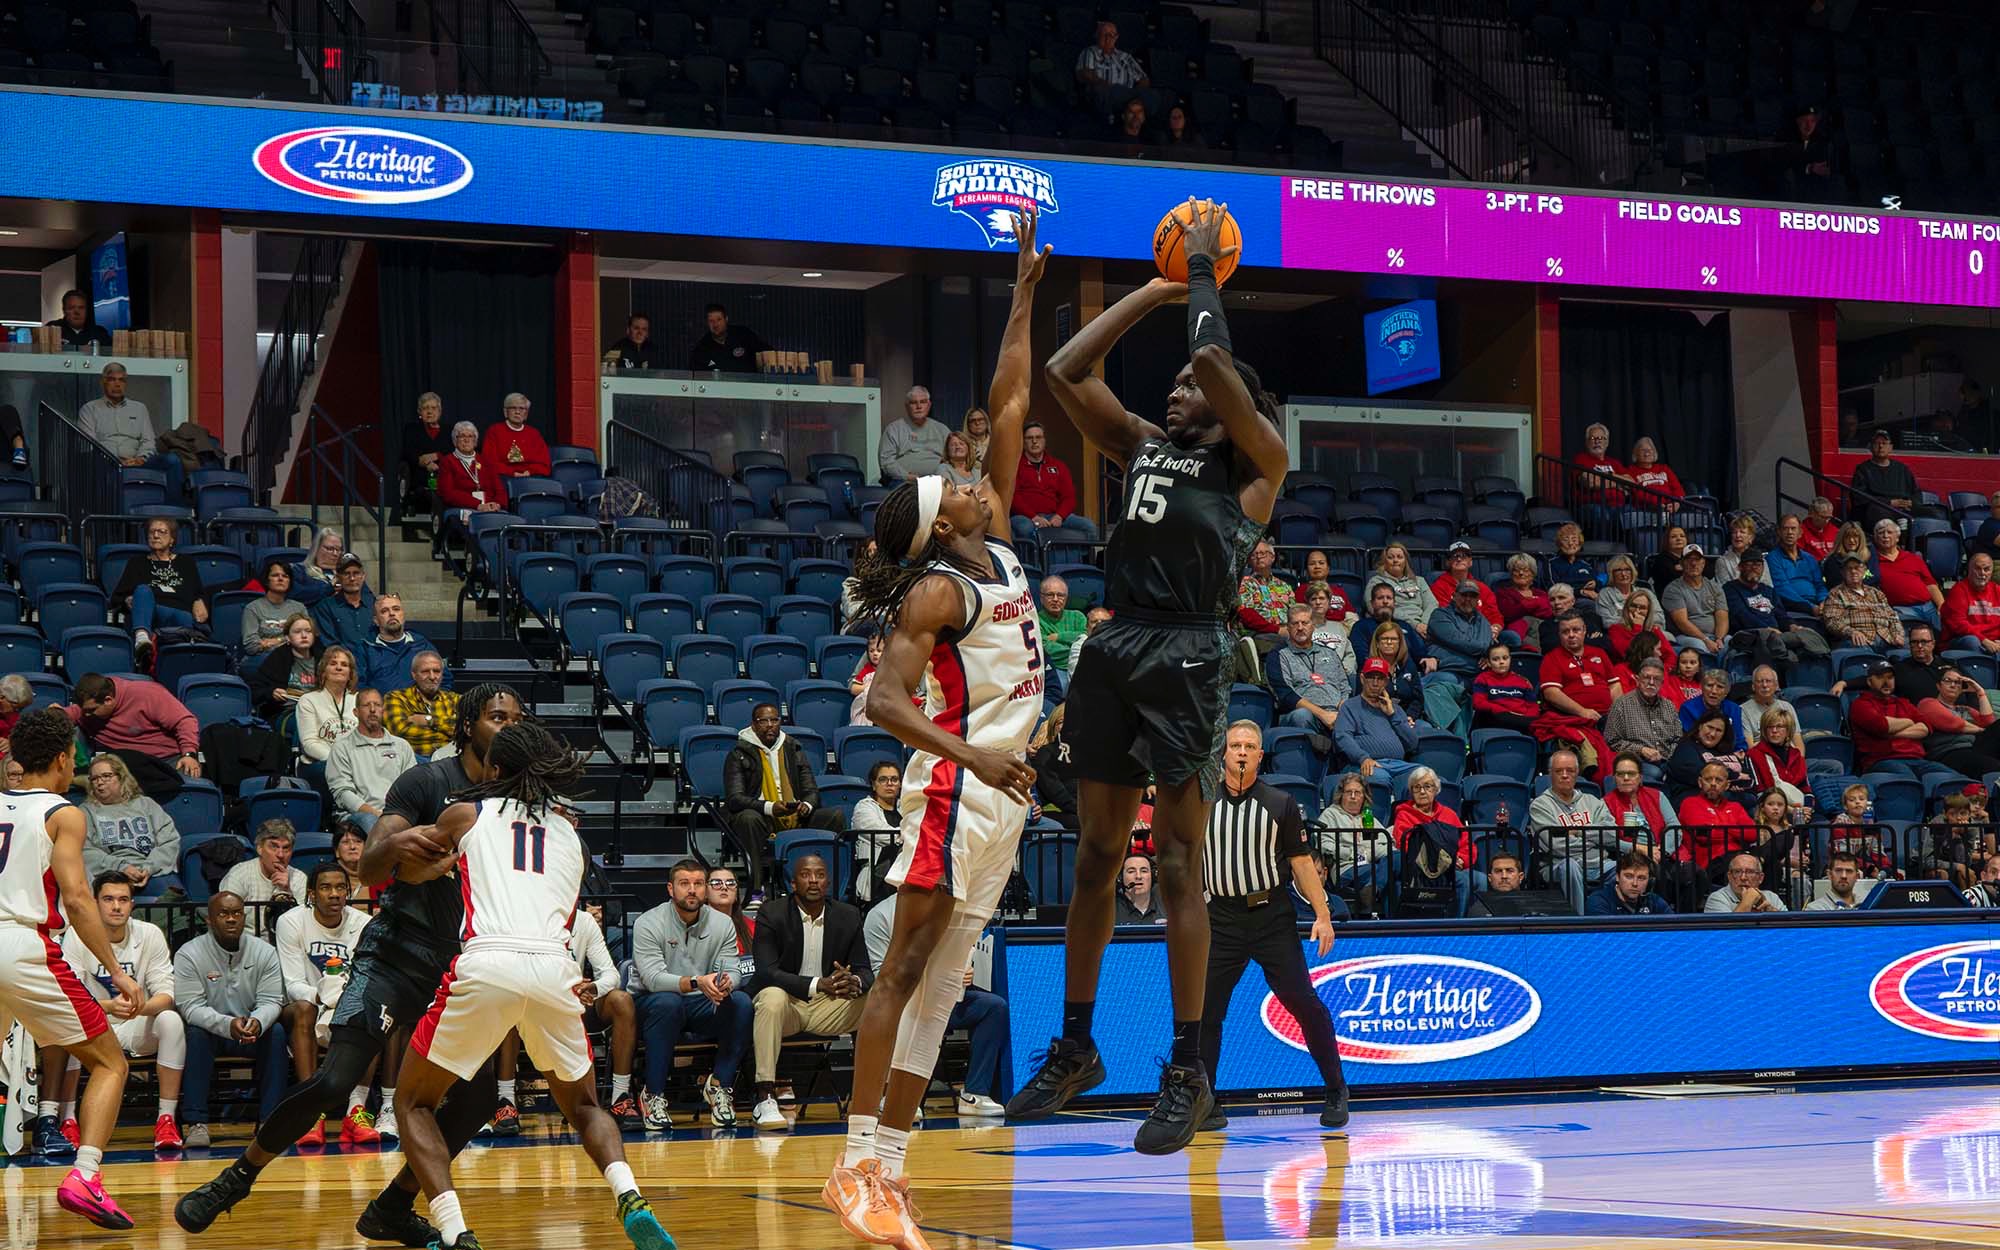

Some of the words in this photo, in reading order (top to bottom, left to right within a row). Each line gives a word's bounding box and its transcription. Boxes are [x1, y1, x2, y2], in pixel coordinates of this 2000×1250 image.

[314, 137, 436, 184] Heritage
[320, 169, 404, 183] PETROLEUM
[939, 163, 1051, 190] SOUTHERN
[936, 176, 1055, 206] INDIANA
[959, 194, 1003, 205] SCREAMING
[1005, 195, 1032, 209] EAGLES
[1291, 179, 1345, 201] FREE
[1349, 183, 1436, 207] THROWS
[1486, 193, 1532, 213] 3-PT.
[1538, 196, 1564, 214] FG
[1619, 201, 1672, 222] FIELD
[1676, 205, 1741, 226] GOALS
[1779, 212, 1880, 235] REBOUNDS
[1919, 220, 1967, 240] TEAM
[1973, 223, 2000, 241] FO
[1968, 249, 1984, 275] 0
[1161, 456, 1206, 478] ROCK
[1127, 473, 1174, 524] 15
[1019, 620, 1042, 672] 5
[510, 820, 546, 876] 11
[1908, 890, 1931, 902] POSS
[311, 942, 349, 960] USI
[1938, 957, 2000, 1000] He
[1339, 973, 1493, 1030] Heritage
[1946, 999, 2000, 1013] PETRO
[1349, 1017, 1455, 1033] PETROLEUM
[1474, 1018, 1496, 1028] LLC
[1257, 1090, 1304, 1099] DAKTRONICS
